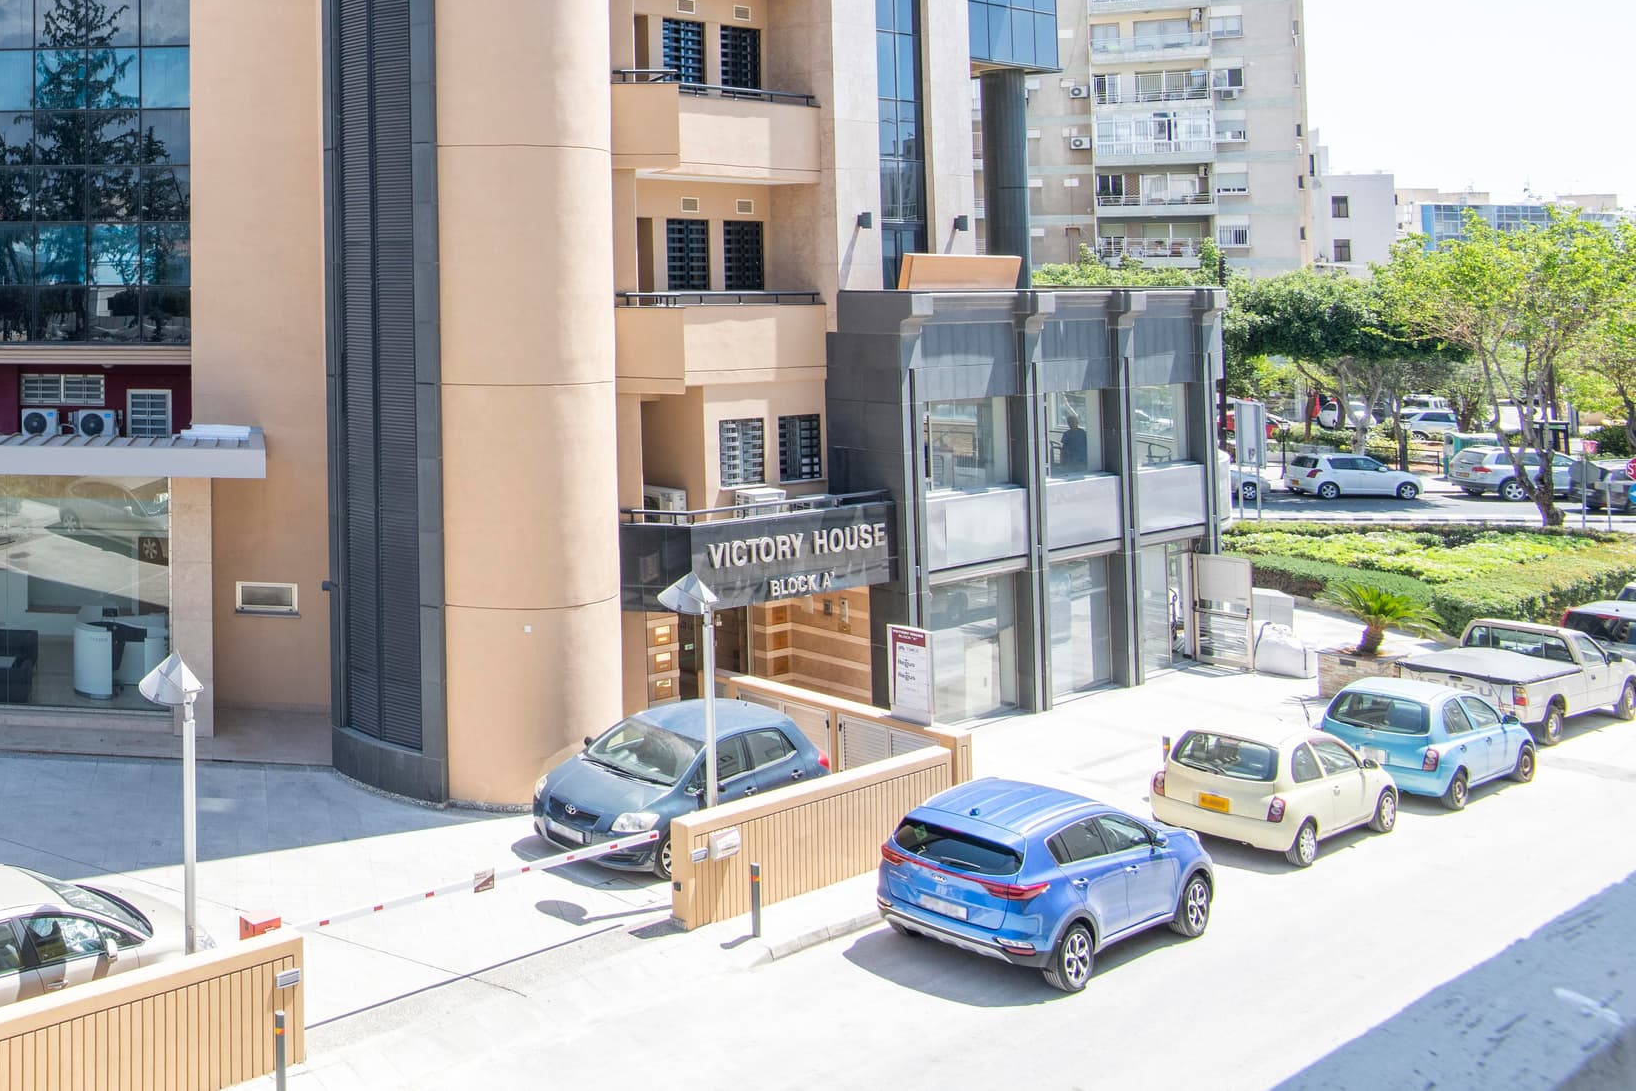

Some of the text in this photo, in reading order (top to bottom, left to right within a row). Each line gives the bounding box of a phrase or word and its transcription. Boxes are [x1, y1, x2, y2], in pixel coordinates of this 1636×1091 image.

[708, 523, 887, 570] VICTORY HOUSE
[769, 574, 816, 597] BLOCK
